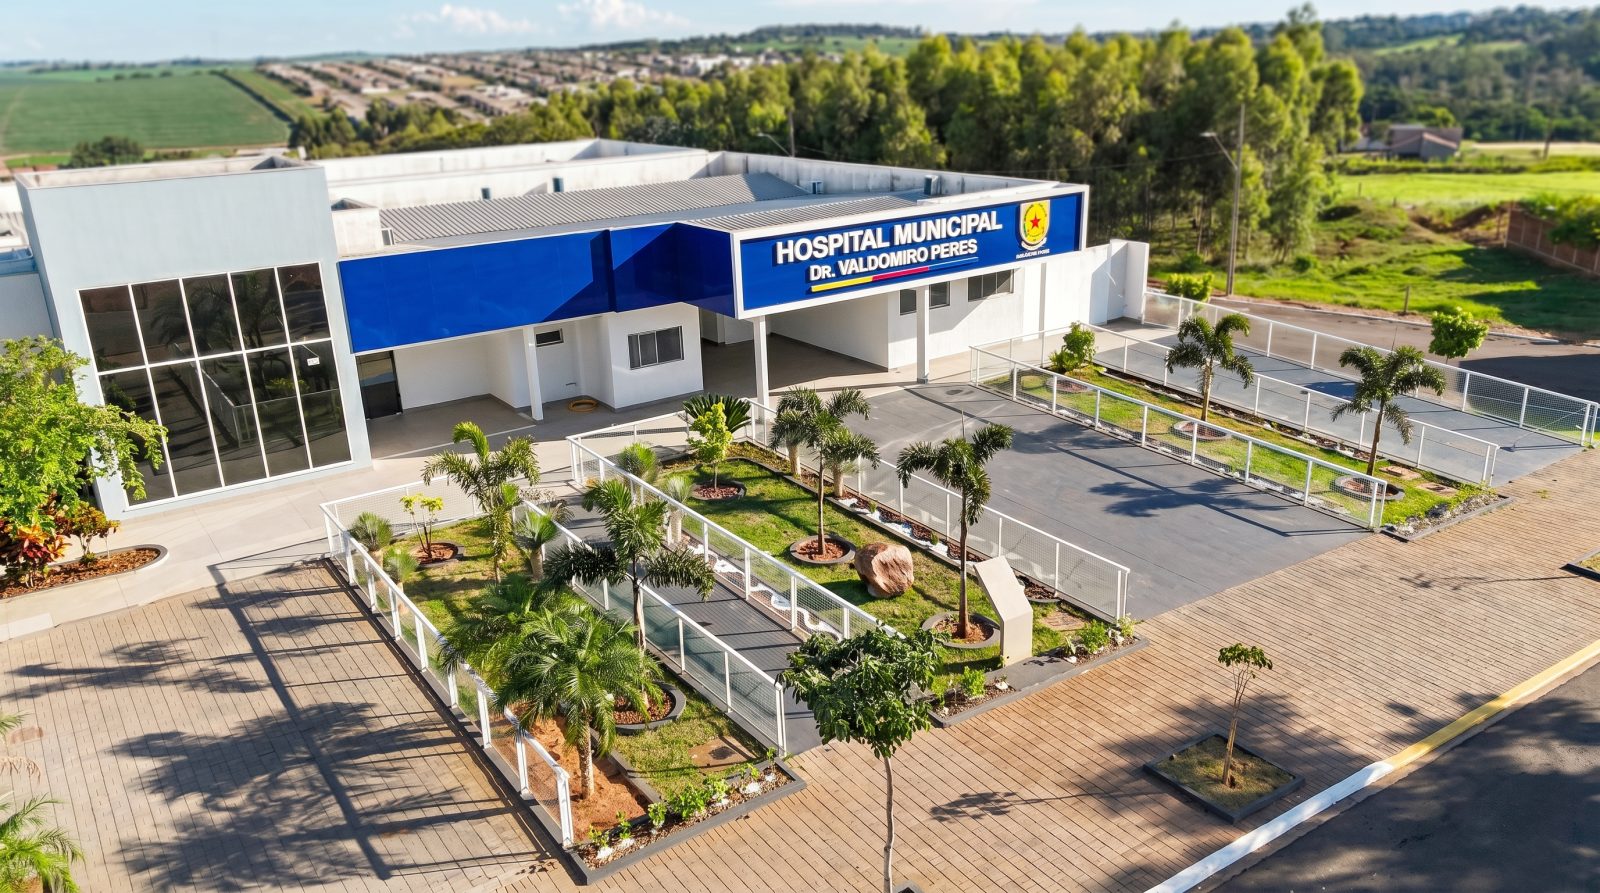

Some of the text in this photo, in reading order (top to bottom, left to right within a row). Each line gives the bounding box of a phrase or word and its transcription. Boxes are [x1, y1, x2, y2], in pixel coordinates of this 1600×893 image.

[776, 227, 890, 264] HOSPITAL
[893, 211, 1003, 246] MUNICIPAL
[809, 239, 978, 281] DR. VALDOMIRO PERES
